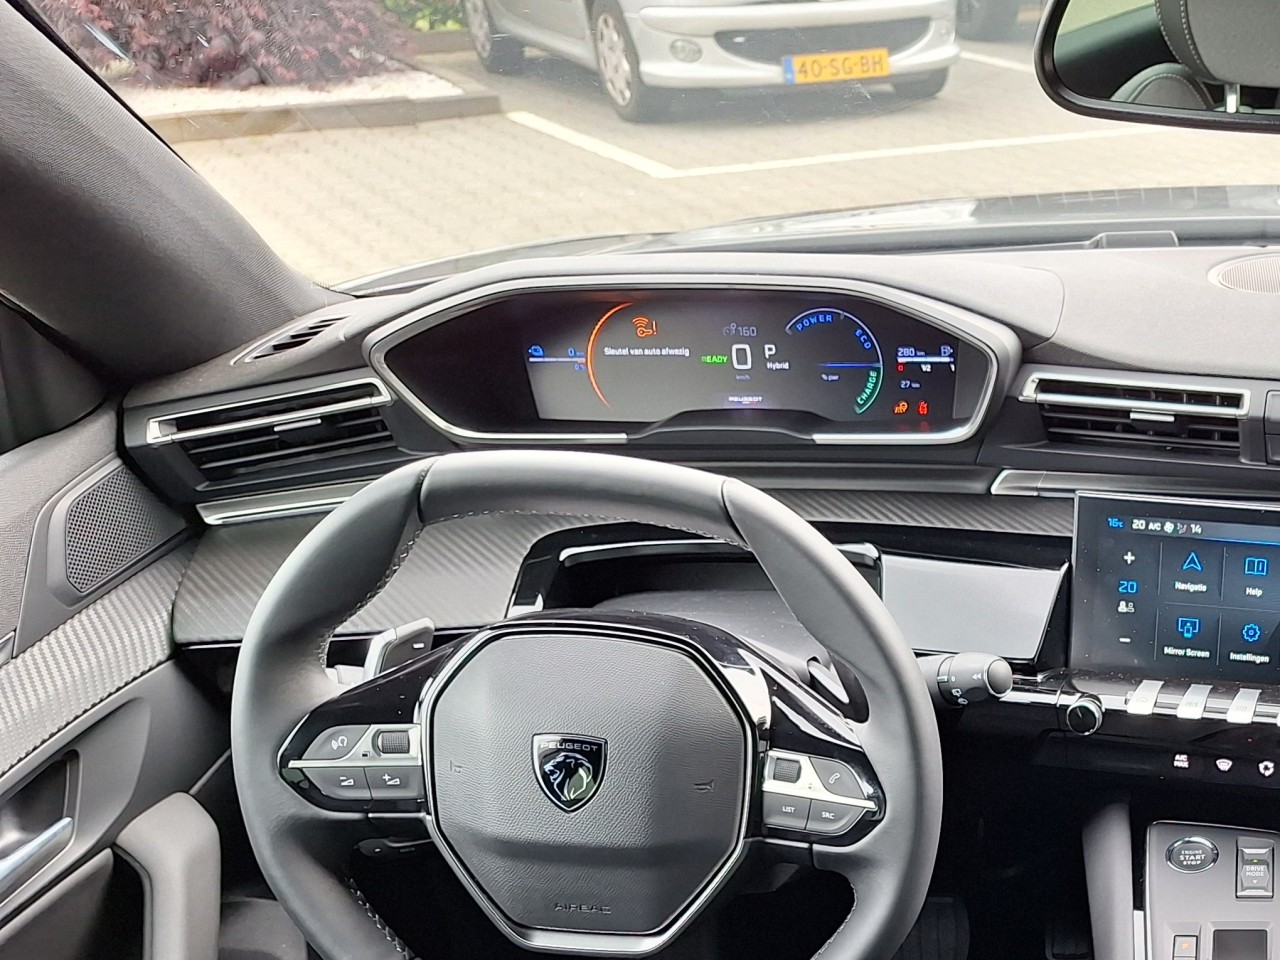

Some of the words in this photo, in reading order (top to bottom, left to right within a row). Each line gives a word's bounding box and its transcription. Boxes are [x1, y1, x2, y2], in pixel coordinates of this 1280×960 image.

[797, 54, 884, 79] 40-SG-BH
[796, 315, 833, 331] POWER
[738, 326, 757, 336] 160
[855, 329, 872, 349] ECO
[604, 347, 629, 355] Sleutel
[630, 347, 643, 355] van
[661, 347, 690, 357] afwezig
[731, 344, 752, 370] 0
[764, 344, 776, 359] P
[897, 347, 915, 357] 280
[701, 355, 728, 363] READY
[766, 361, 790, 371] Hybrid
[856, 370, 878, 404] CHARGE
[1132, 518, 1146, 530] 20
[1148, 521, 1162, 531] A/C
[1190, 524, 1202, 534] 14
[1118, 580, 1137, 593] 20
[1174, 581, 1207, 593] Navigatie
[1245, 587, 1263, 598] Help
[1163, 646, 1186, 656] Mirror
[1185, 648, 1210, 658] Screen
[1229, 651, 1270, 664] Instellingen
[540, 741, 599, 752] PEUGEOT
[1173, 760, 1189, 768] MAX
[782, 805, 796, 814] LIST
[821, 811, 836, 820] SRC
[1179, 853, 1207, 861] START
[554, 902, 612, 915] AIRBAG
